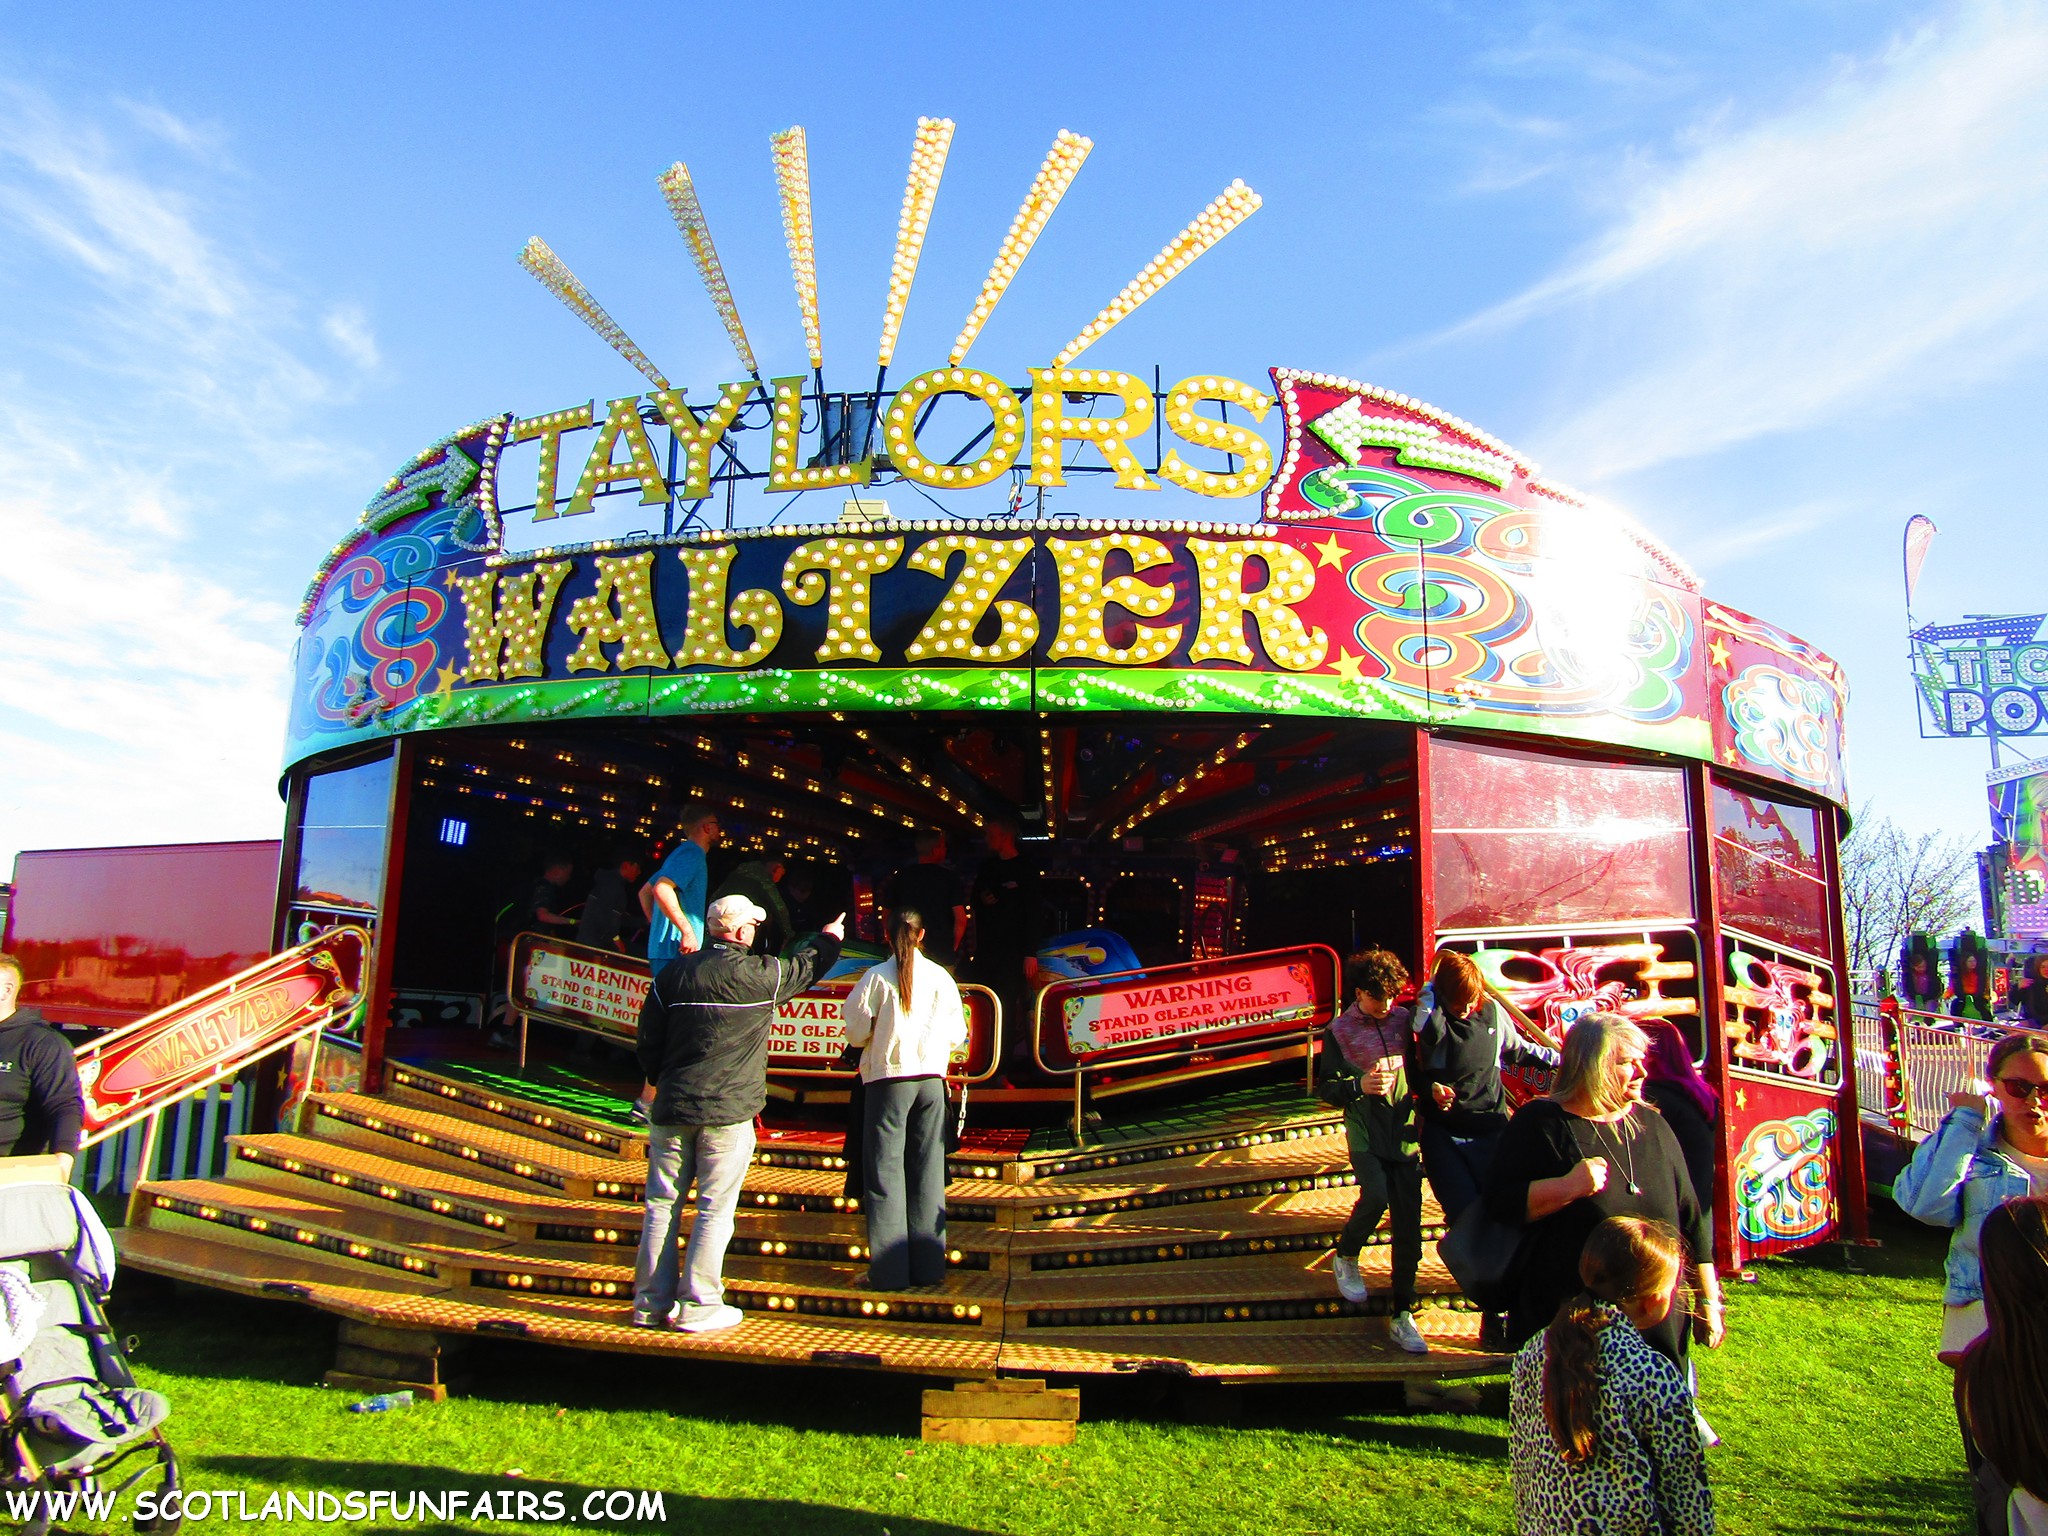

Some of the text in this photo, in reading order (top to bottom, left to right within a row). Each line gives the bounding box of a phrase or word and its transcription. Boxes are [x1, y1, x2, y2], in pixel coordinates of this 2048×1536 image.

[508, 366, 1276, 523] TAYLORS
[456, 533, 1332, 684] WALTZER
[1945, 647, 2048, 687] TEC
[1948, 689, 2048, 733] PO
[541, 974, 580, 994] STAND
[1123, 976, 1253, 1010] WARNING
[551, 992, 578, 1008] RIDE
[582, 998, 593, 1012] IS
[597, 1003, 609, 1017] IN
[612, 1007, 639, 1024] MOT
[1088, 991, 1292, 1032] STAND CLEAR WHILST
[1110, 1008, 1276, 1045] RIDE IS IN MOTION
[139, 985, 295, 1079] WALTZER
[768, 1040, 845, 1054] IDE IS IN
[801, 1023, 846, 1038] CLEA
